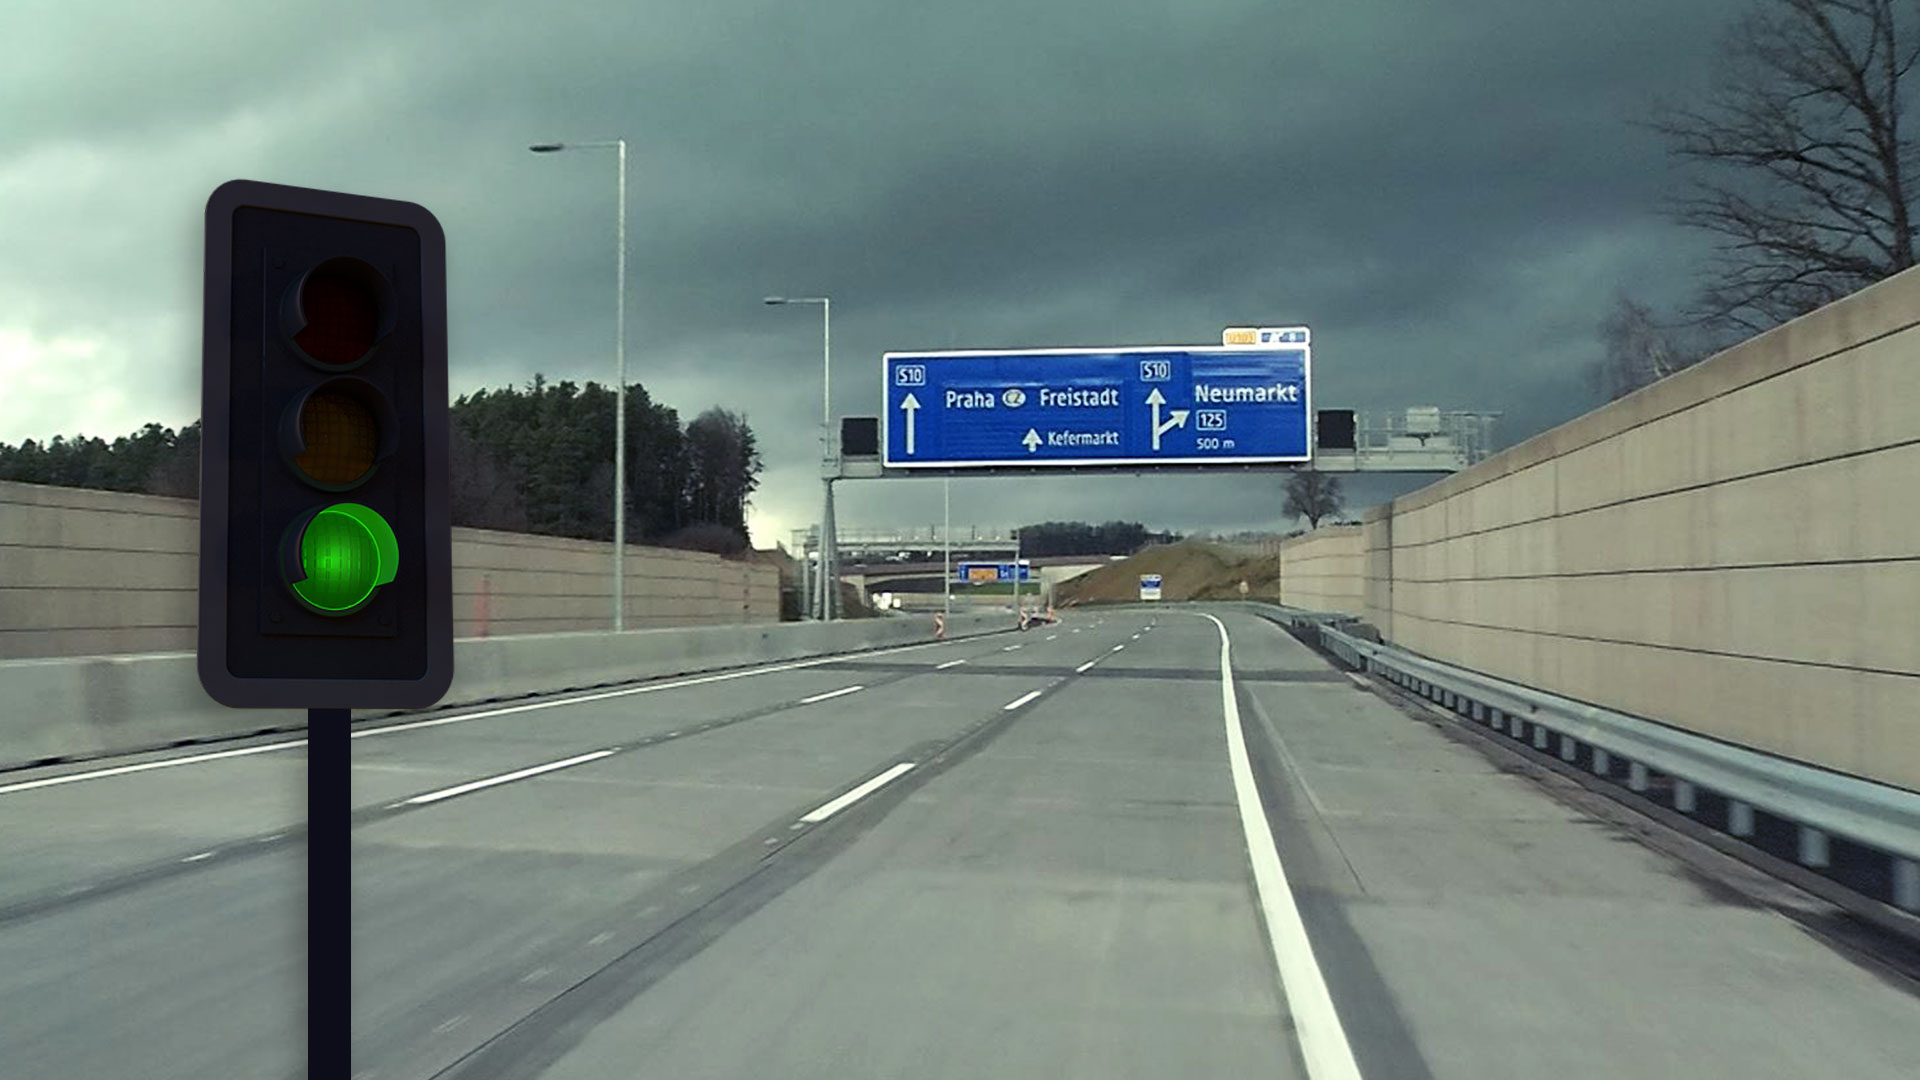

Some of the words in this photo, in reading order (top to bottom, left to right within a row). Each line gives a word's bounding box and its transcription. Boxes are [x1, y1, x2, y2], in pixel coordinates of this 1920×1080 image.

[898, 368, 922, 383] S10
[1143, 364, 1167, 379] S10
[946, 391, 995, 408] Praha
[1040, 387, 1119, 406] Freistadt
[1195, 384, 1298, 403] Neumarkt
[1201, 414, 1223, 427] 125
[1047, 431, 1120, 446] Kefermarkt
[1196, 438, 1219, 450] 500
[1223, 440, 1235, 449] m
